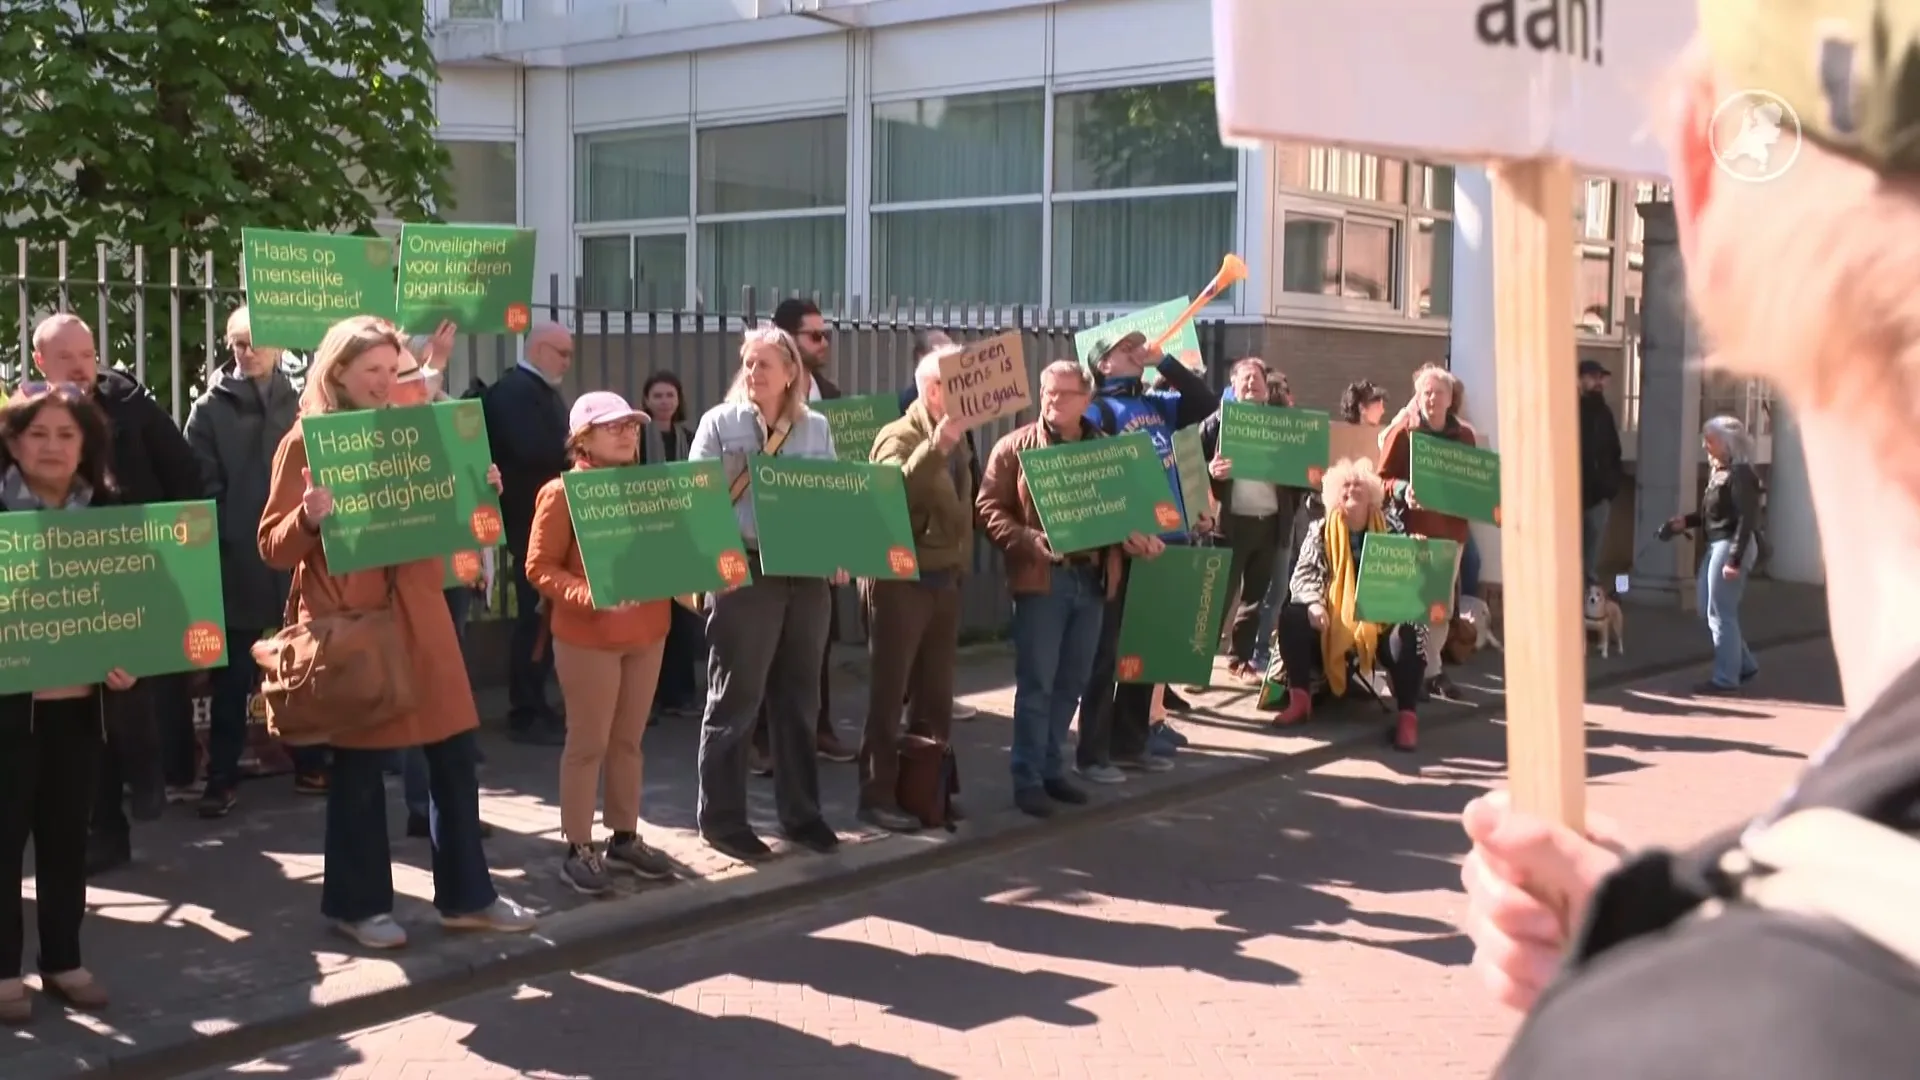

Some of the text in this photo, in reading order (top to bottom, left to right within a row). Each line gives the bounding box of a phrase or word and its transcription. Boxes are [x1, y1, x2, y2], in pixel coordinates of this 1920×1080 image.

[313, 248, 335, 266] op
[405, 257, 512, 275] voor kinderen
[252, 267, 343, 290] menselijke
[959, 342, 1006, 369] Geen
[948, 366, 991, 394] mens
[1295, 418, 1320, 432] niet
[391, 426, 418, 449] op
[319, 451, 432, 486] menselijke
[1034, 463, 1125, 490] niet bewezen
[625, 477, 675, 496] zorgen
[678, 473, 709, 489] over
[49, 553, 156, 579] bewezen
